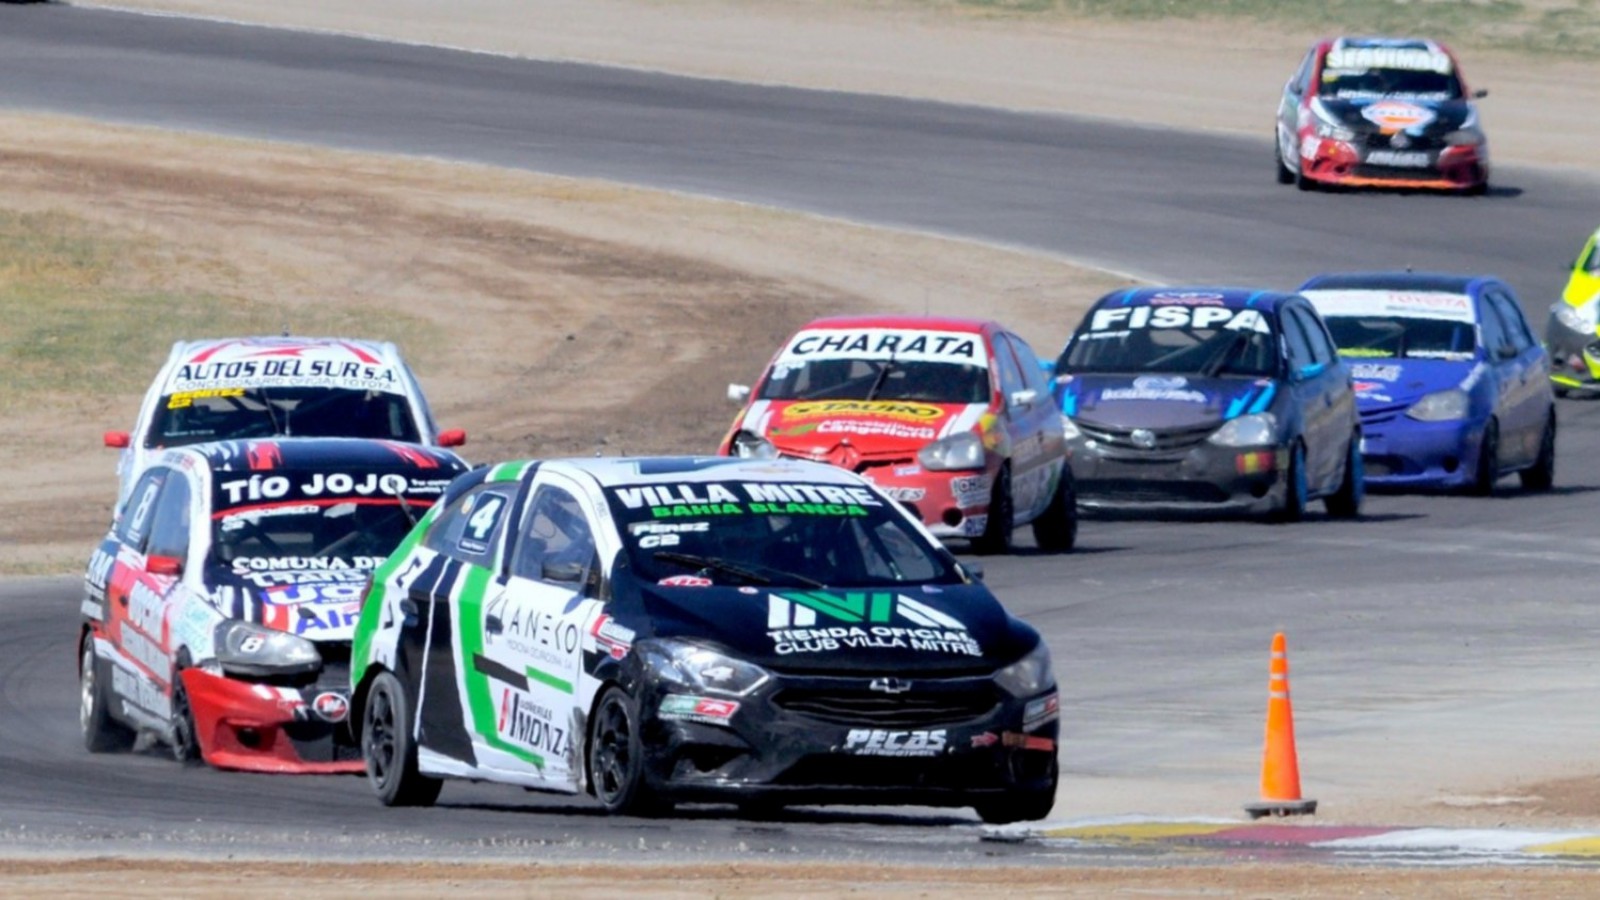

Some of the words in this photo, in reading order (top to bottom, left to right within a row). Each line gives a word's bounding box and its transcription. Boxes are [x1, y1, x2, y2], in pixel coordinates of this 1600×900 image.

[1091, 306, 1271, 334] FISPA
[791, 333, 975, 359] CHARATA
[176, 363, 256, 382] AUTOS
[262, 360, 306, 378] DEL
[311, 361, 360, 379] SUR
[221, 474, 291, 504] TÍO
[301, 473, 407, 495] JOJO
[615, 484, 742, 509] VILLA
[742, 483, 884, 507] MITRE
[469, 498, 502, 539] 4
[652, 504, 744, 519] BAHIA
[750, 503, 870, 517] BLANCA
[231, 556, 348, 571] COMUNA
[241, 637, 264, 657] 8
[767, 627, 869, 644] TIENDA
[869, 627, 973, 645] OFICIAL
[774, 636, 841, 656] CLUB
[842, 636, 910, 649] VILLA
[910, 639, 984, 658] MITRE
[846, 728, 948, 751] PECAS
